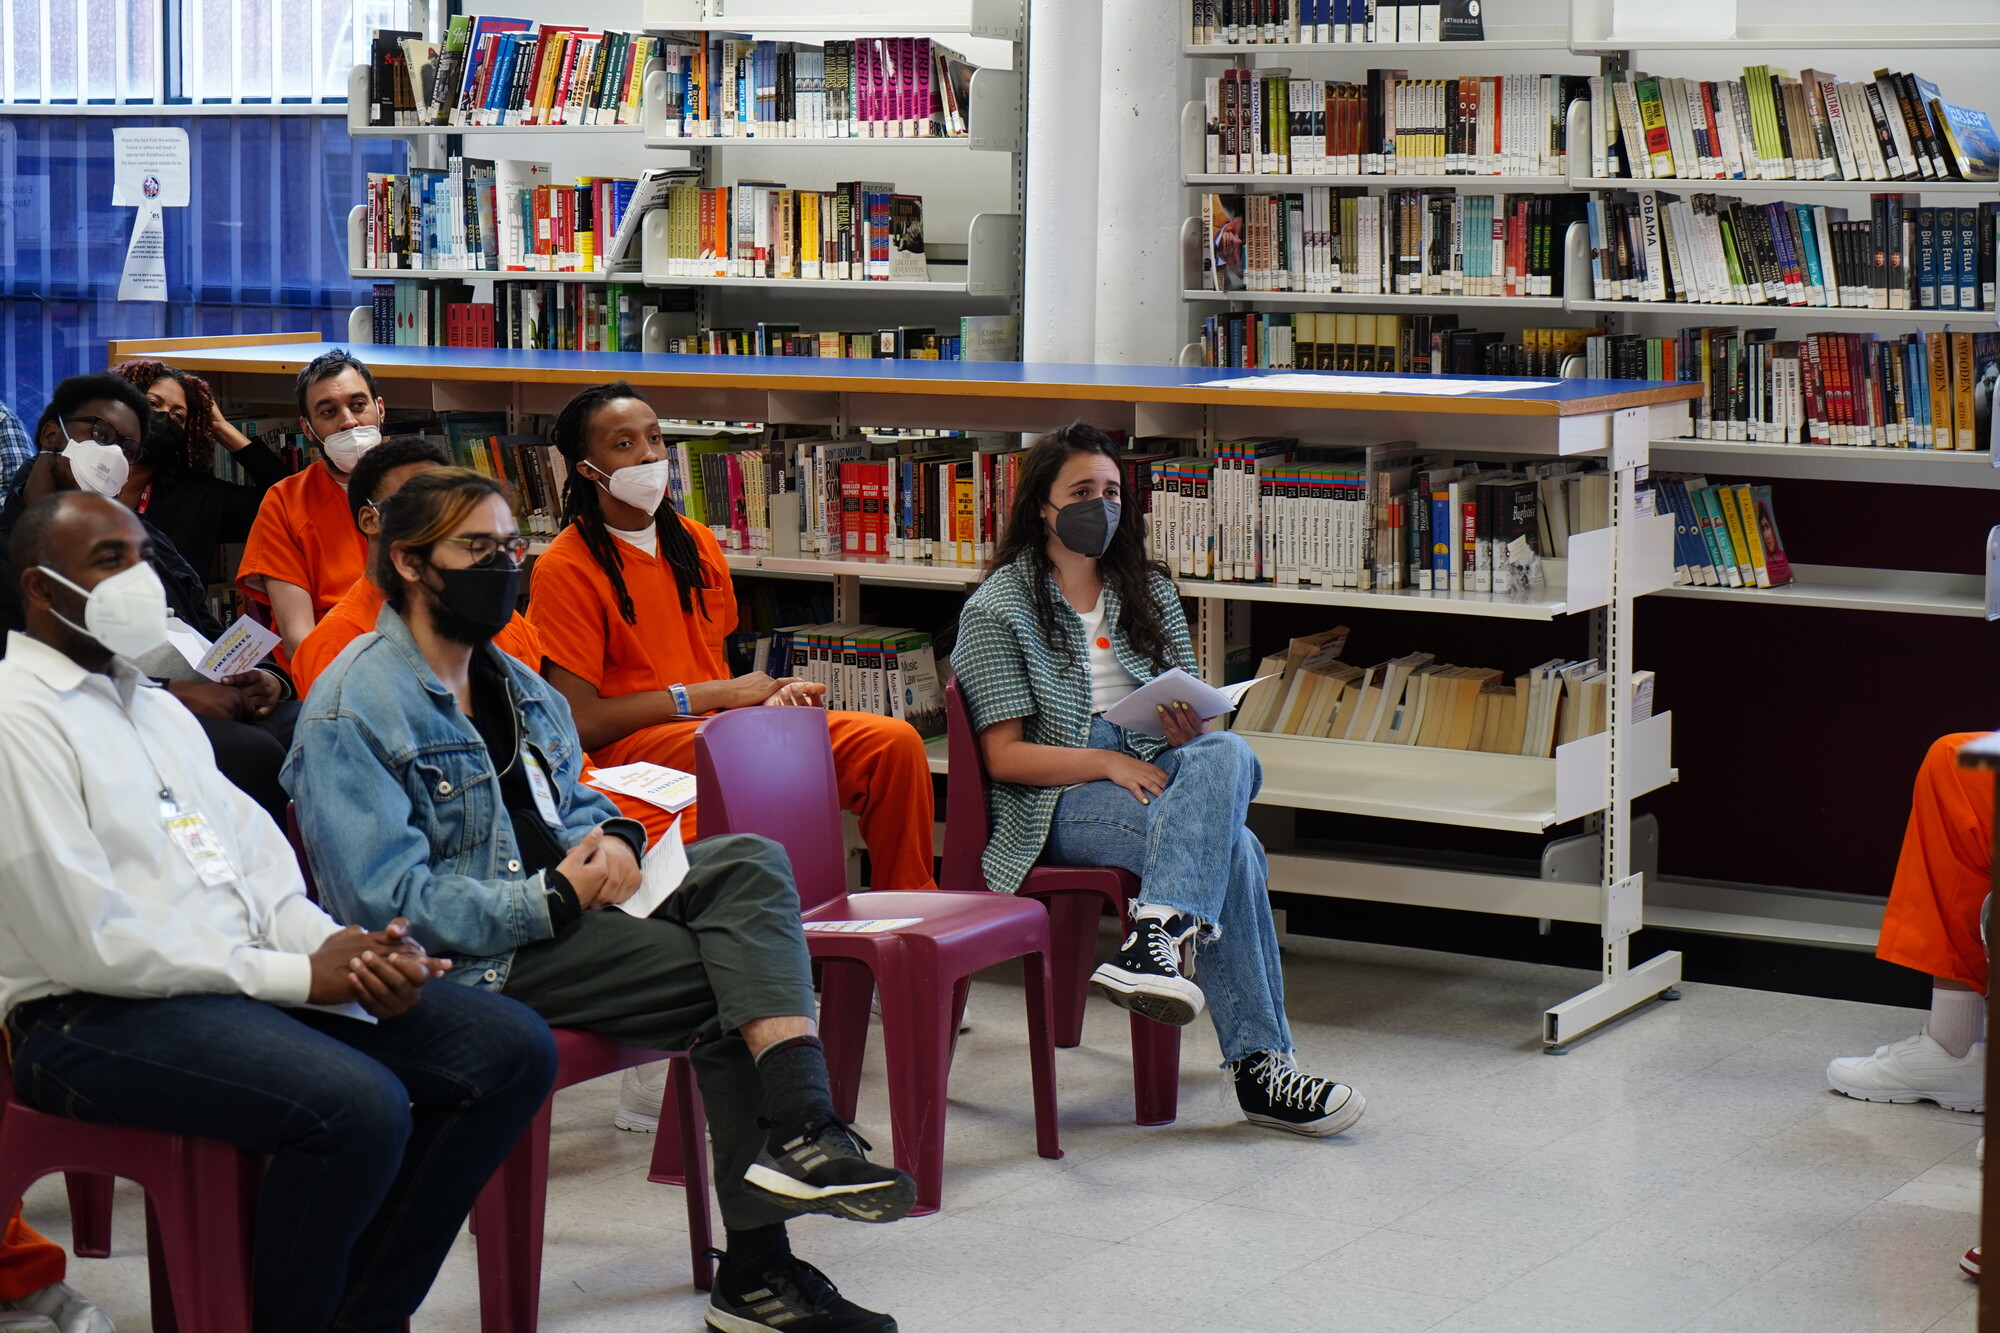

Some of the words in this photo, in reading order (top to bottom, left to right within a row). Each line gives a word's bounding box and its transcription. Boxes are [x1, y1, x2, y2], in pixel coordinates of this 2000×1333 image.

[566, 34, 574, 54] STAGING
[826, 46, 834, 54] THE
[838, 46, 846, 54] THE
[560, 56, 570, 90] SHAKESPEARE
[825, 57, 836, 88] AVIATORS
[837, 56, 848, 88] AVIATORS
[903, 39, 913, 85] WIRED
[919, 38, 928, 85] WIRED
[604, 72, 612, 94] STANDS
[1824, 82, 1840, 118] SOLITARY
[1644, 103, 1655, 126] FREEDOM
[1705, 102, 1713, 126] ANGELOU
[1901, 98, 1911, 118] DIRTY
[1908, 119, 1919, 137] JOHN
[1915, 101, 1925, 118] DIRTY
[1921, 120, 1932, 138] JOHN
[1945, 105, 1986, 121] TREVOR
[1952, 115, 1983, 127] NOAH
[837, 195, 849, 231] GENERALS
[900, 205, 913, 214] TOM
[1643, 195, 1657, 247] OBAMA
[1921, 231, 1931, 245] BIG
[1942, 230, 1952, 245] BIG
[1962, 231, 1972, 245] BIG
[1922, 249, 1932, 272] FELLA
[1942, 248, 1952, 272] FELLA
[1963, 249, 1973, 272] FELLA
[1808, 336, 1819, 363] HAROLD
[1803, 361, 1810, 372] WE
[1935, 341, 1946, 392] WOODEN
[1959, 342, 1970, 393] WOODEN
[1804, 373, 1813, 397] REAPED
[825, 461, 840, 480] RUN
[1514, 491, 1534, 503] Vincent
[1744, 503, 1750, 512] Am
[1466, 516, 1475, 527] ANN
[1513, 504, 1536, 524] Bugliosi
[1725, 502, 1731, 511] Am
[1728, 512, 1738, 534] Malala
[1466, 528, 1475, 541] RULE
[213, 634, 251, 672] PRESENTS
[901, 660, 918, 673] Music
[904, 674, 916, 686] Law
[647, 775, 690, 794] PRESENTS
